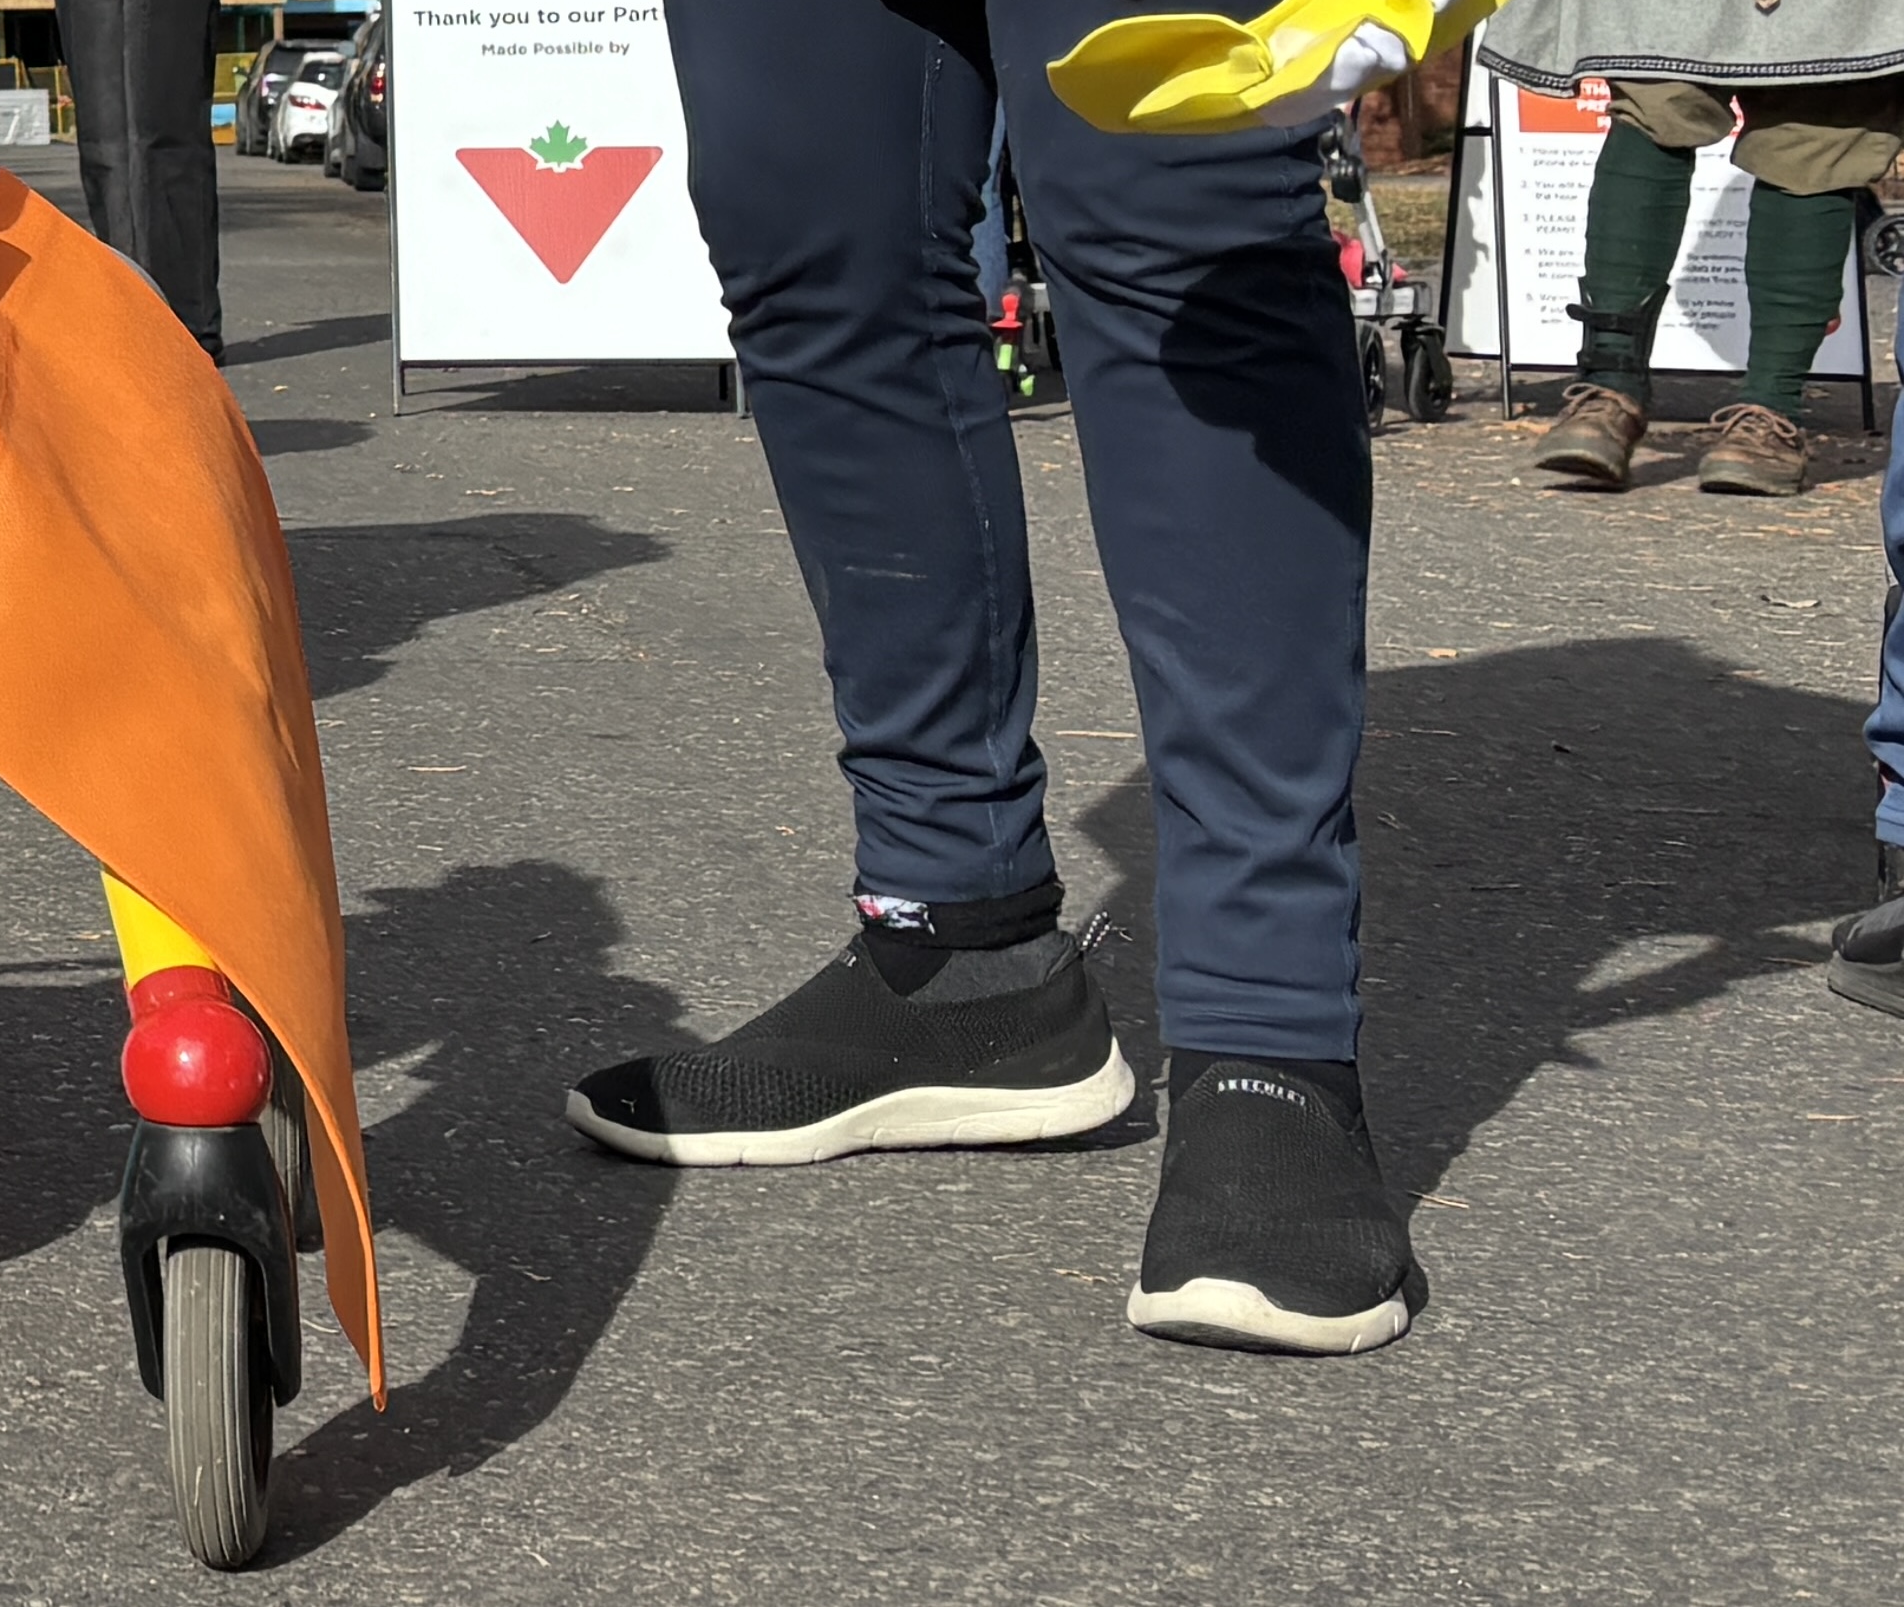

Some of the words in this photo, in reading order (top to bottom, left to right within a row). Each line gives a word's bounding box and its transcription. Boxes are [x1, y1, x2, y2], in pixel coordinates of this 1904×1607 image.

[413, 9, 481, 27] Thank
[489, 11, 530, 28] you
[538, 9, 560, 24] to
[568, 9, 605, 24] our
[613, 6, 662, 23] Part
[481, 43, 527, 56] Made
[533, 41, 603, 55] Possible
[609, 40, 630, 56] by
